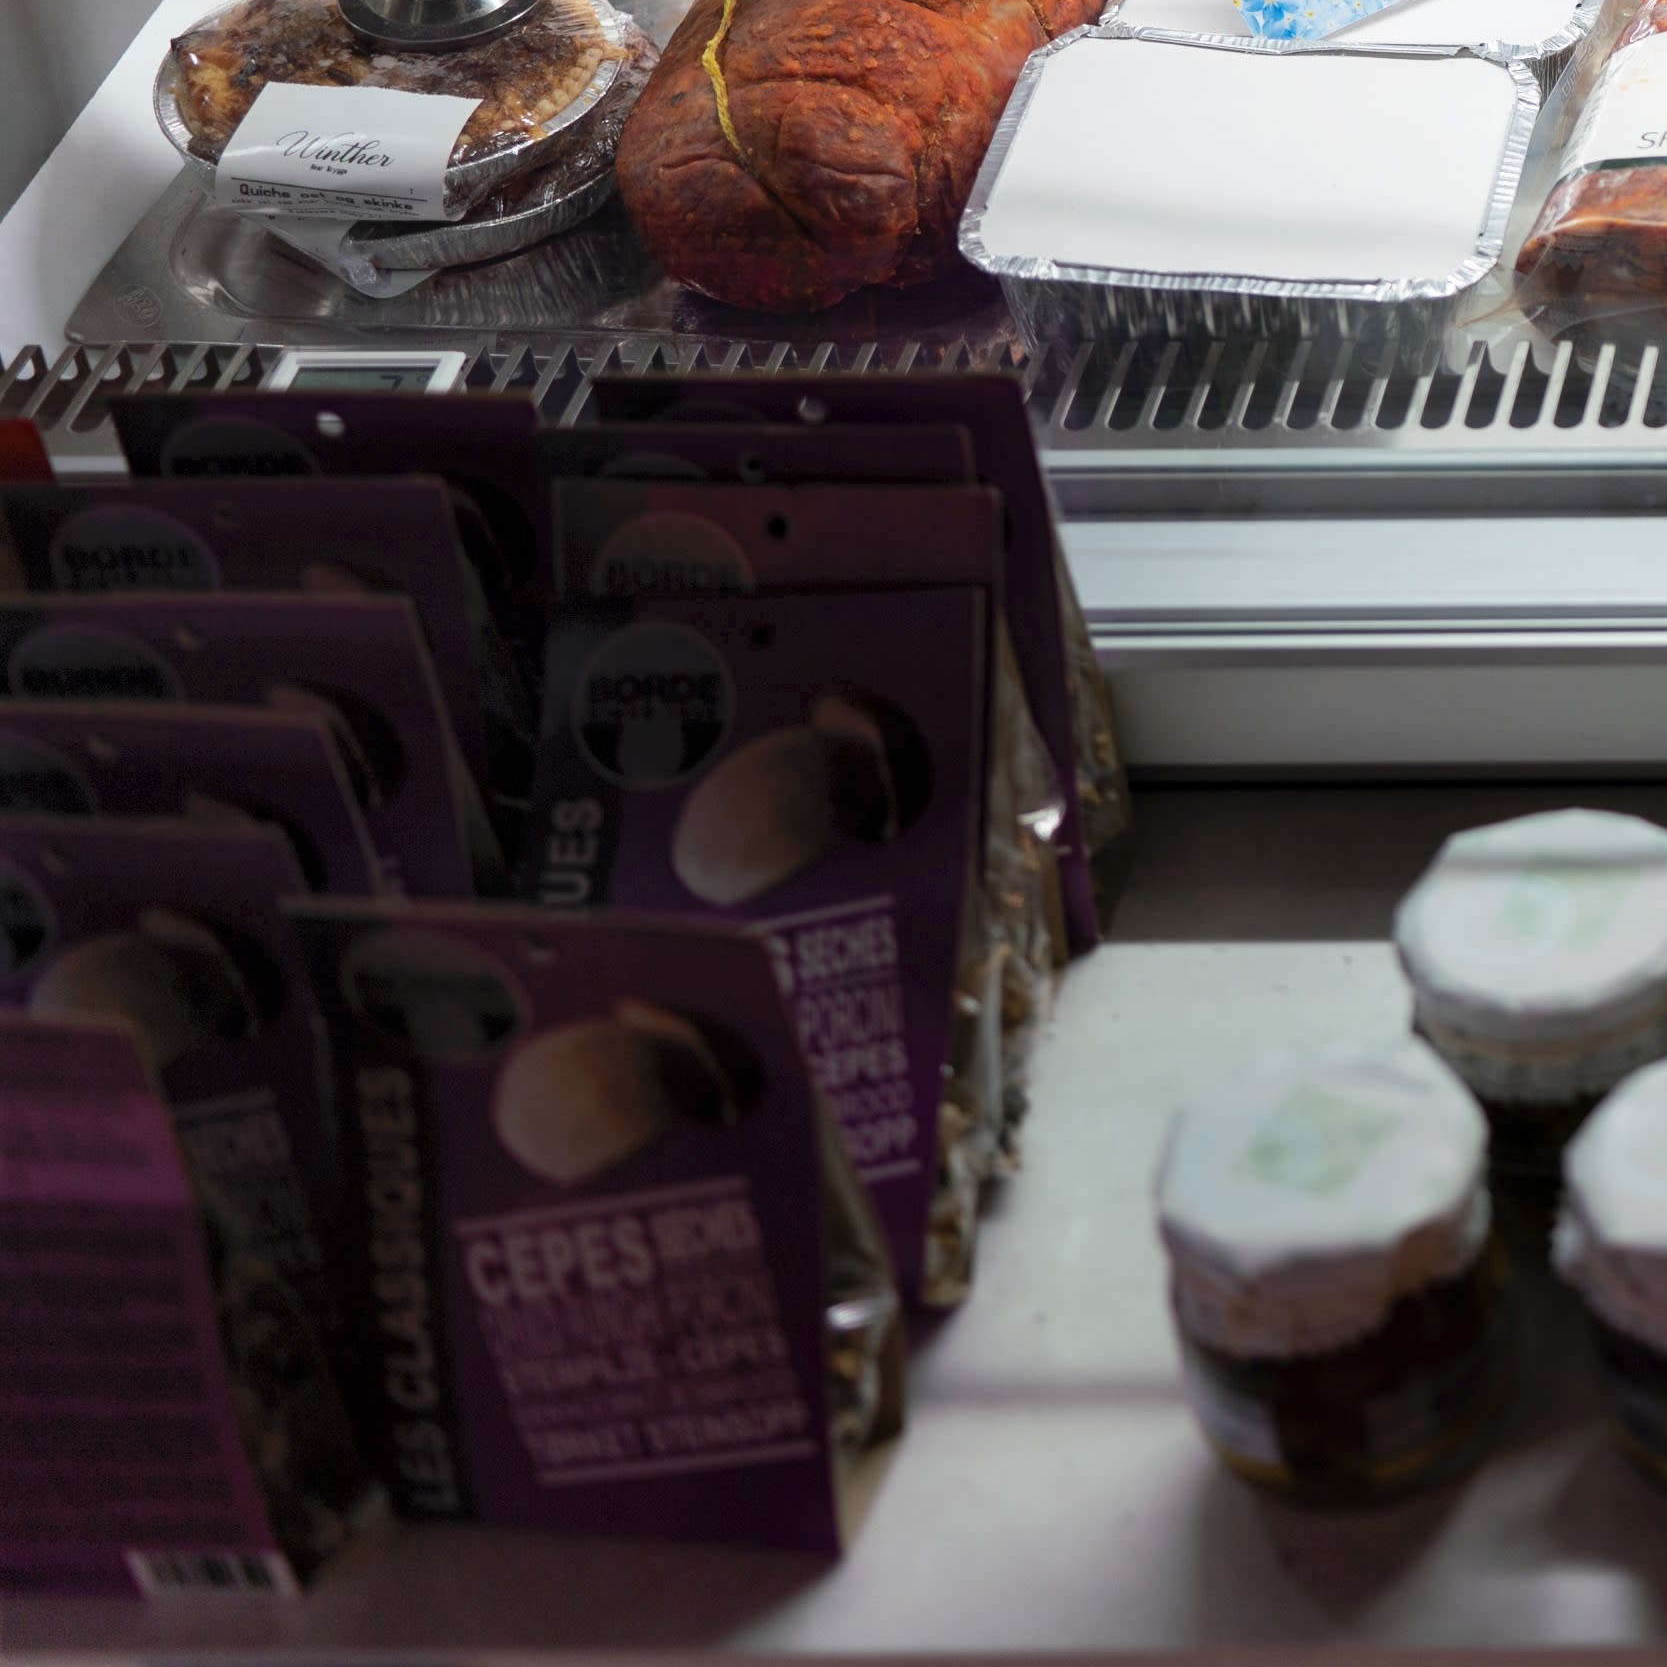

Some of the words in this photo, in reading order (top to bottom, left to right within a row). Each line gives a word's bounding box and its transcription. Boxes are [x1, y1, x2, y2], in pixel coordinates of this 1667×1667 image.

[276, 130, 397, 168] Winther
[239, 183, 292, 198] Quiche
[364, 198, 414, 210] skinke
[365, 1065, 438, 1411] CLASSIQUES
[463, 1216, 656, 1309] CEPES
